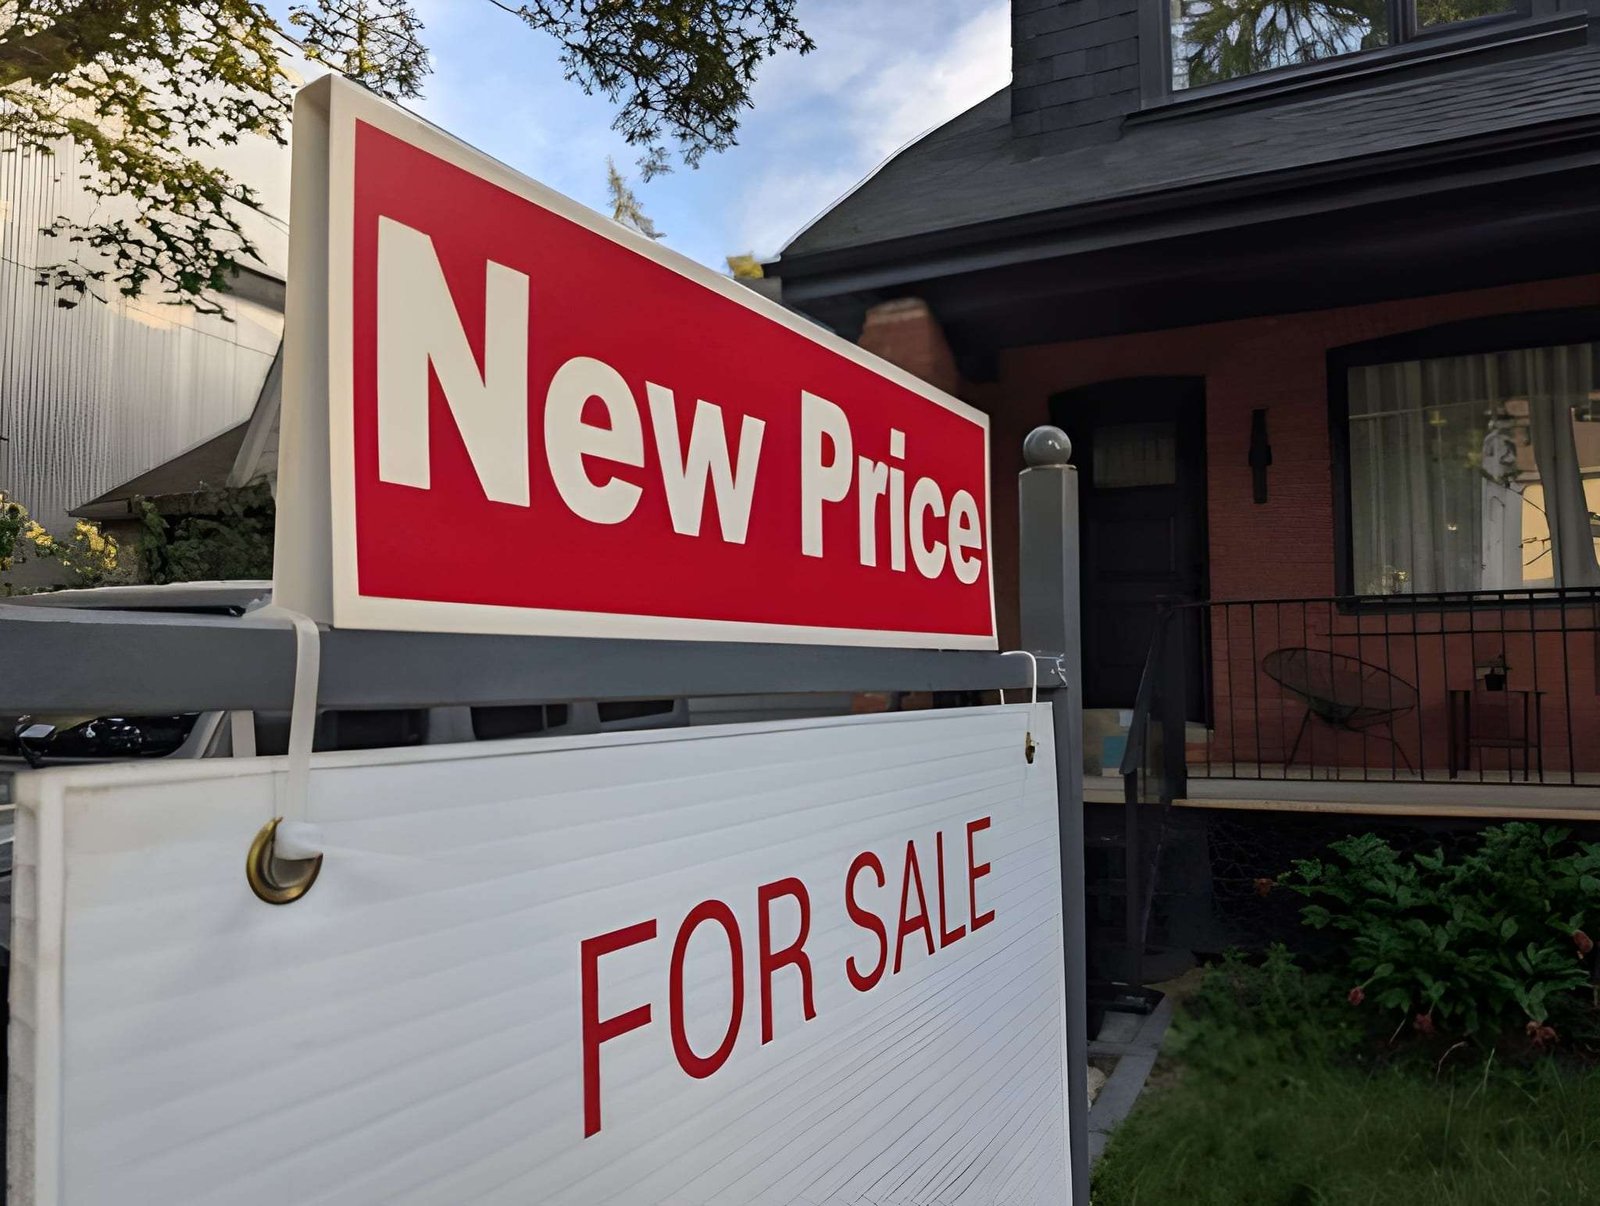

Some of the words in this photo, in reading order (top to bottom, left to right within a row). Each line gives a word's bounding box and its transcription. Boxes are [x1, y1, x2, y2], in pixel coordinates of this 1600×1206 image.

[377, 215, 766, 545] New
[801, 390, 983, 586] Price
[581, 876, 817, 1137] FOR
[845, 816, 996, 992] SALE
